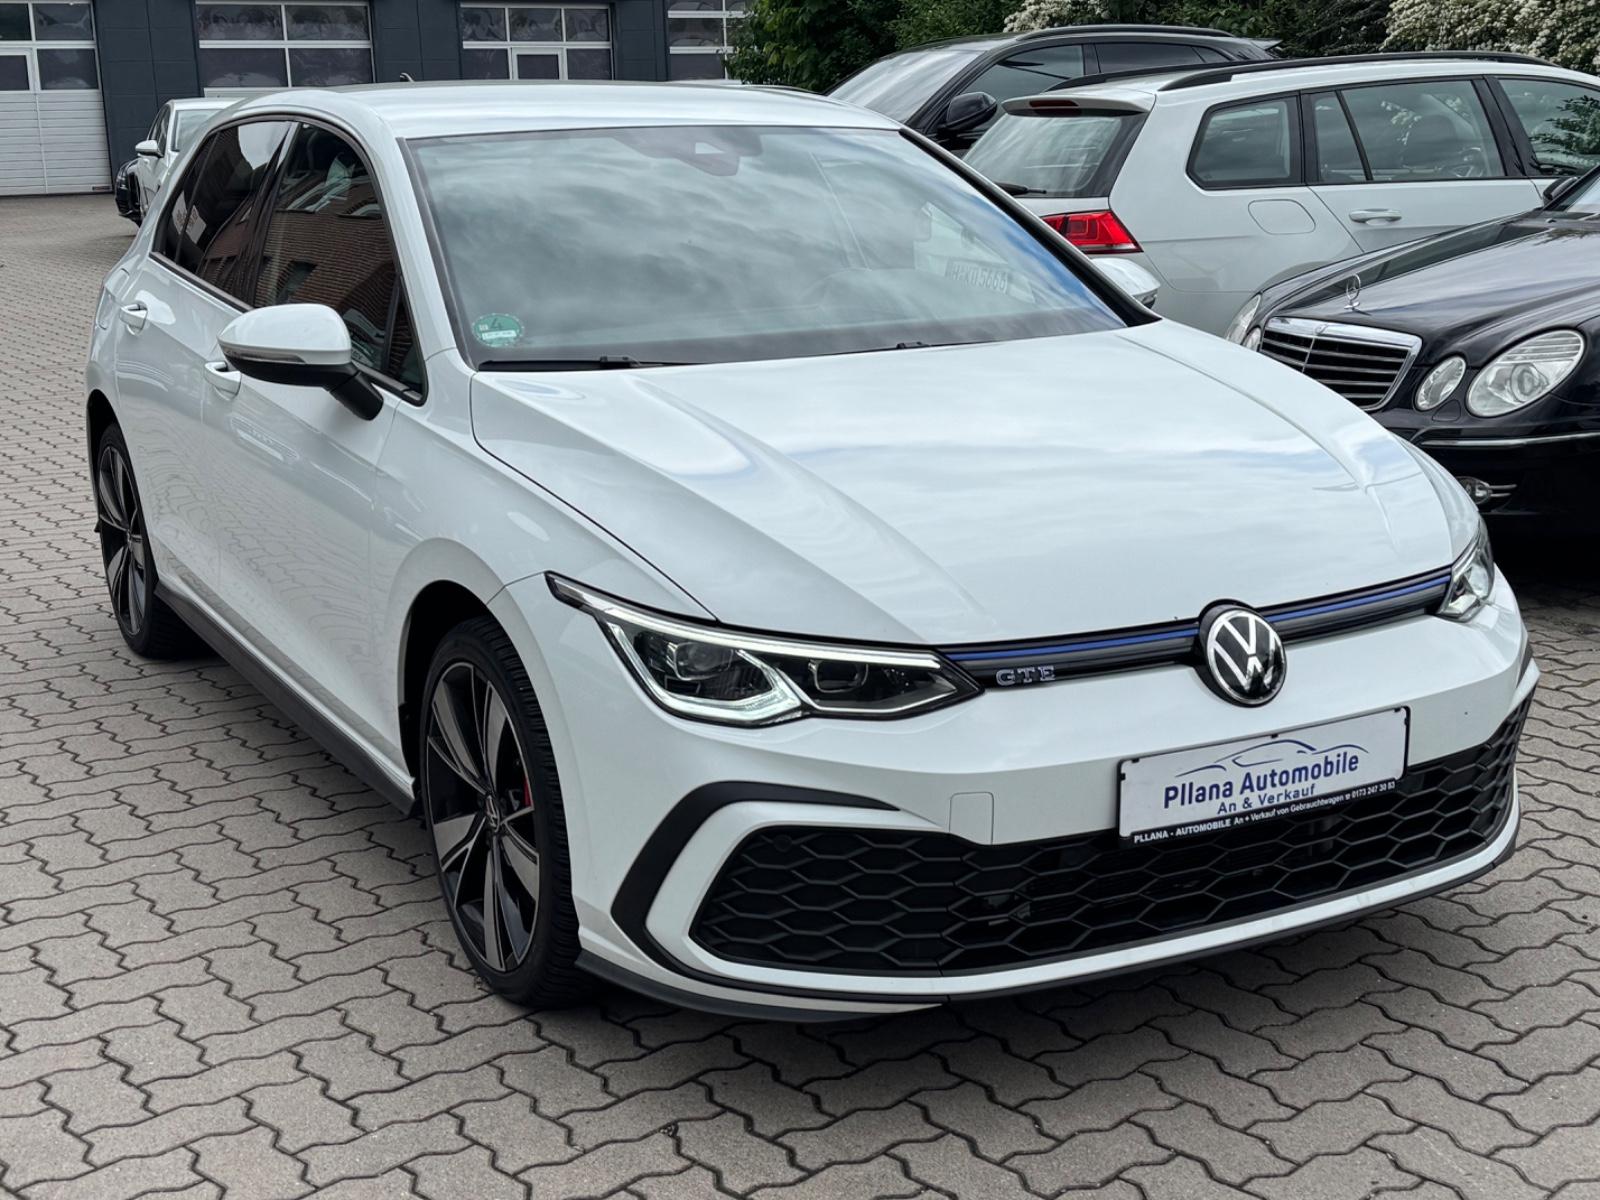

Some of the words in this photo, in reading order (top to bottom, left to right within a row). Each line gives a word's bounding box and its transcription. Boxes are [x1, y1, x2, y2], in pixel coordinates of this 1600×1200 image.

[996, 665, 1056, 686] GTE
[1163, 781, 1233, 809] Pllana
[1239, 751, 1359, 795] Automobile
[1217, 802, 1237, 814] An
[1242, 796, 1253, 809] &
[1258, 783, 1316, 806] Verkauf
[1134, 830, 1169, 843] PLLANA
[1175, 819, 1231, 836] AUTOMOBILE
[1234, 816, 1244, 825] An
[1250, 808, 1276, 821] Verkauf
[1277, 807, 1289, 815] von
[1290, 794, 1344, 812] Gebrauchtwagen
[1351, 788, 1367, 799] 0173
